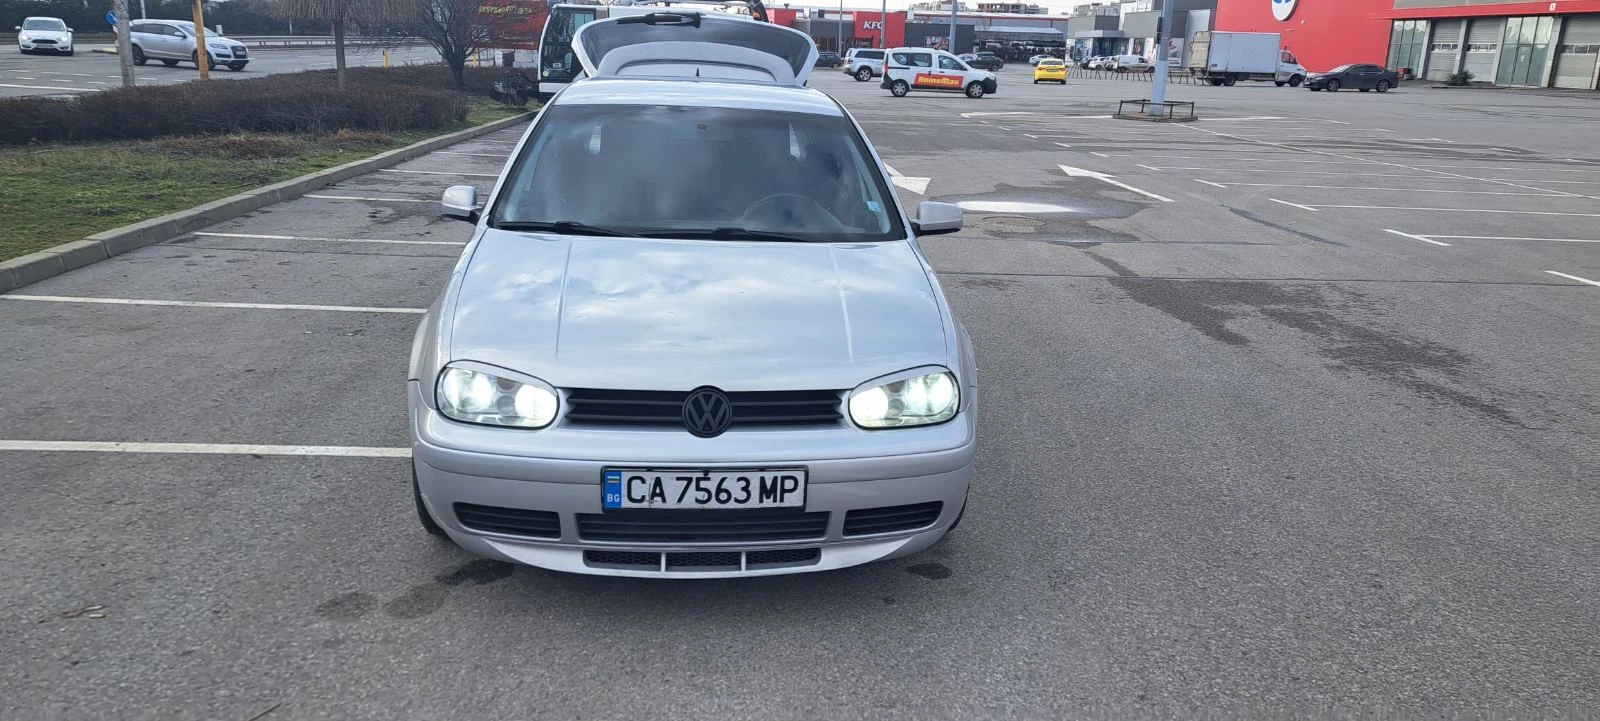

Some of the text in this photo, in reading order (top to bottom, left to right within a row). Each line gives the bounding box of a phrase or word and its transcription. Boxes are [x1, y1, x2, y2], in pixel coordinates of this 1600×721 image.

[918, 76, 960, 85] HomeMan
[626, 475, 799, 505] CA 7563 MP
[606, 493, 620, 503] BG
